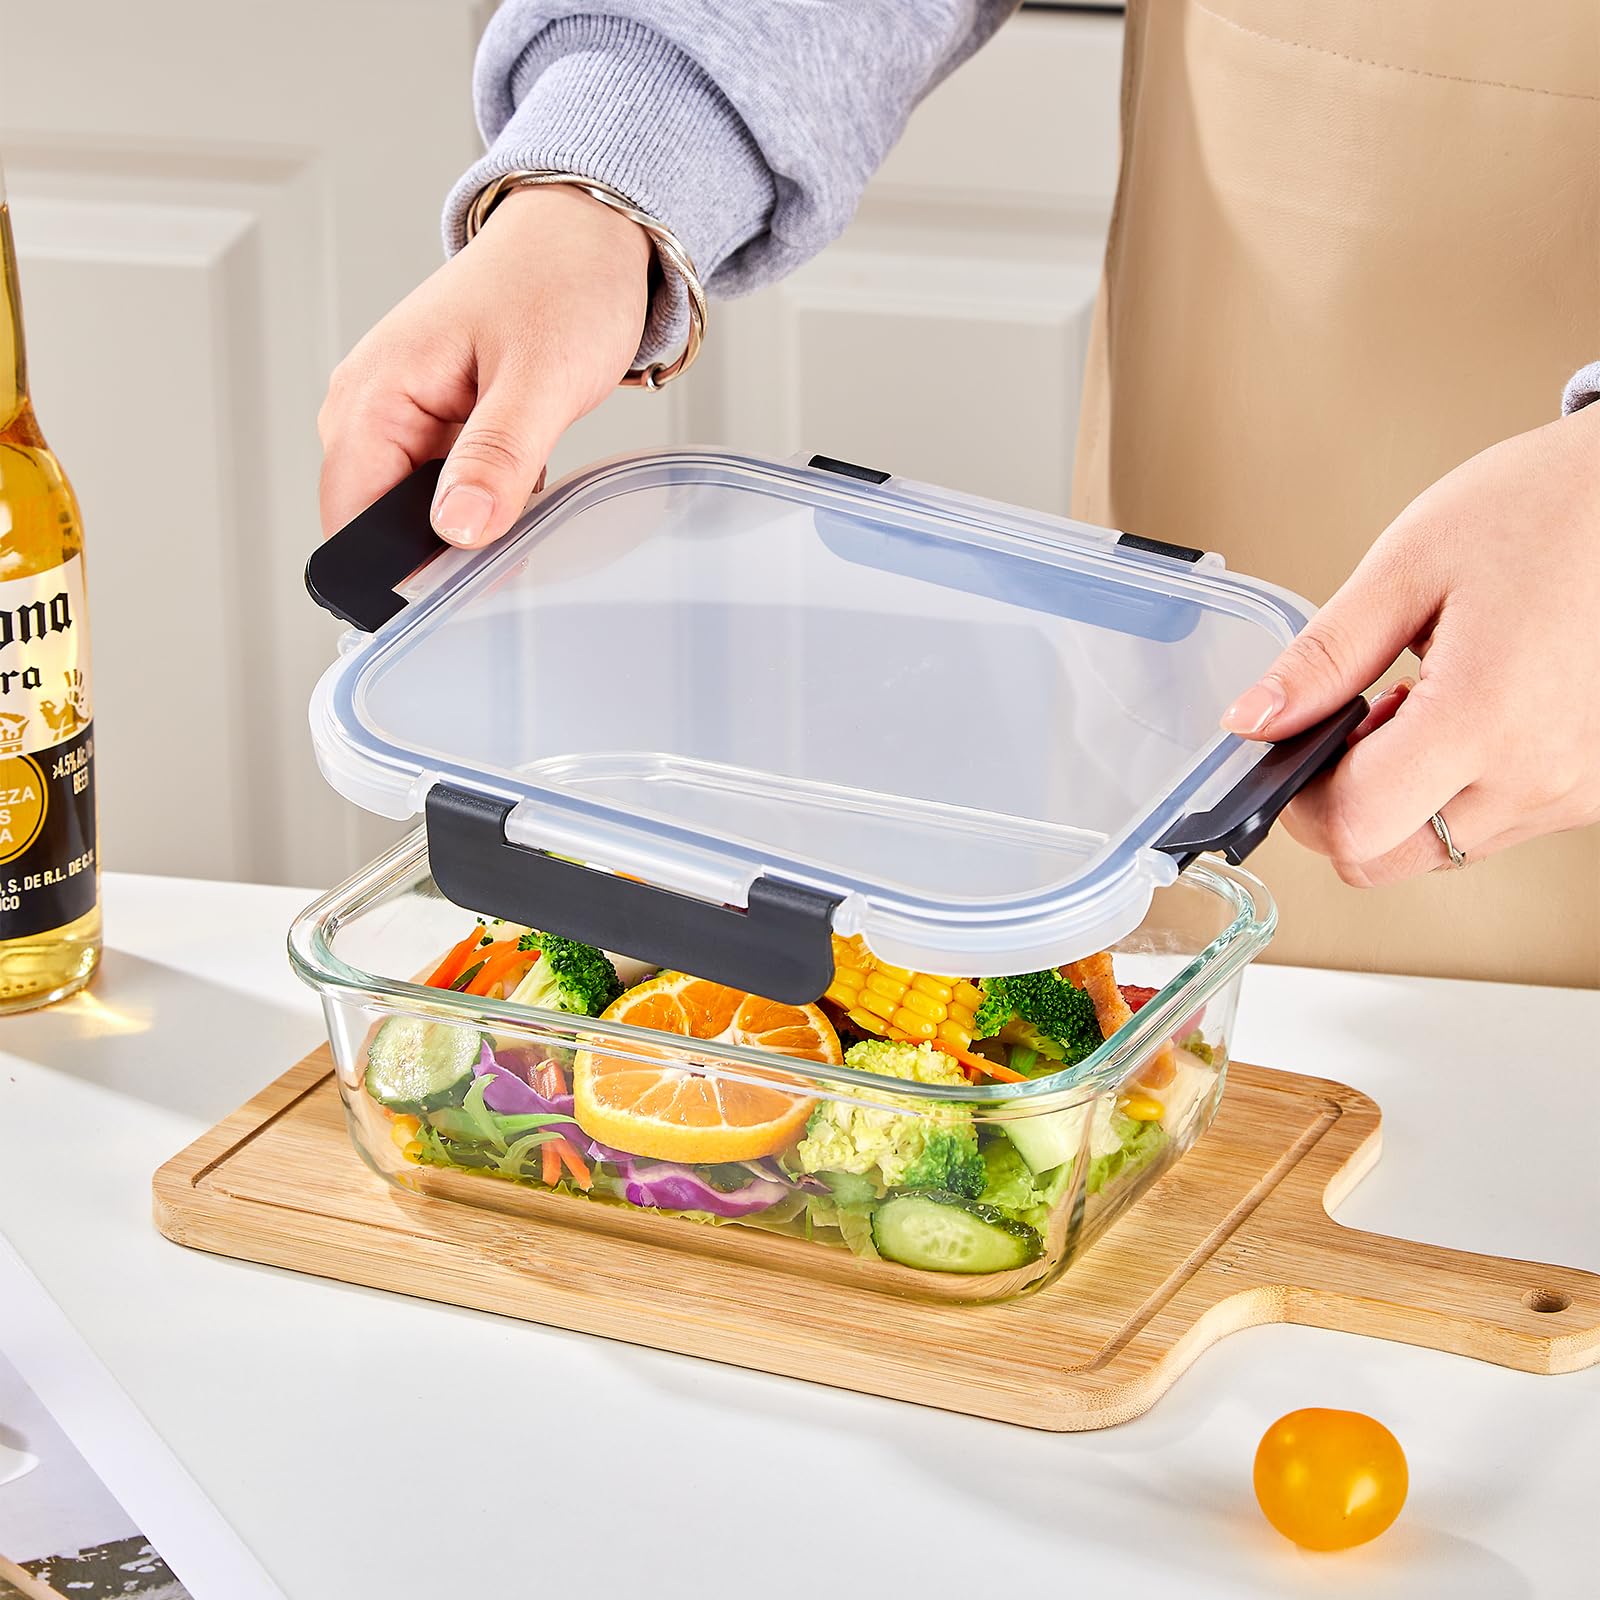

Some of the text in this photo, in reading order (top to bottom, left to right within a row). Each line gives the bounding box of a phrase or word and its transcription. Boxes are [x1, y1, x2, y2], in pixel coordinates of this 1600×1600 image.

[7, 879, 22, 894] S.
[24, 874, 42, 891] DE
[44, 867, 67, 886] R.L.
[68, 858, 82, 877] DE
